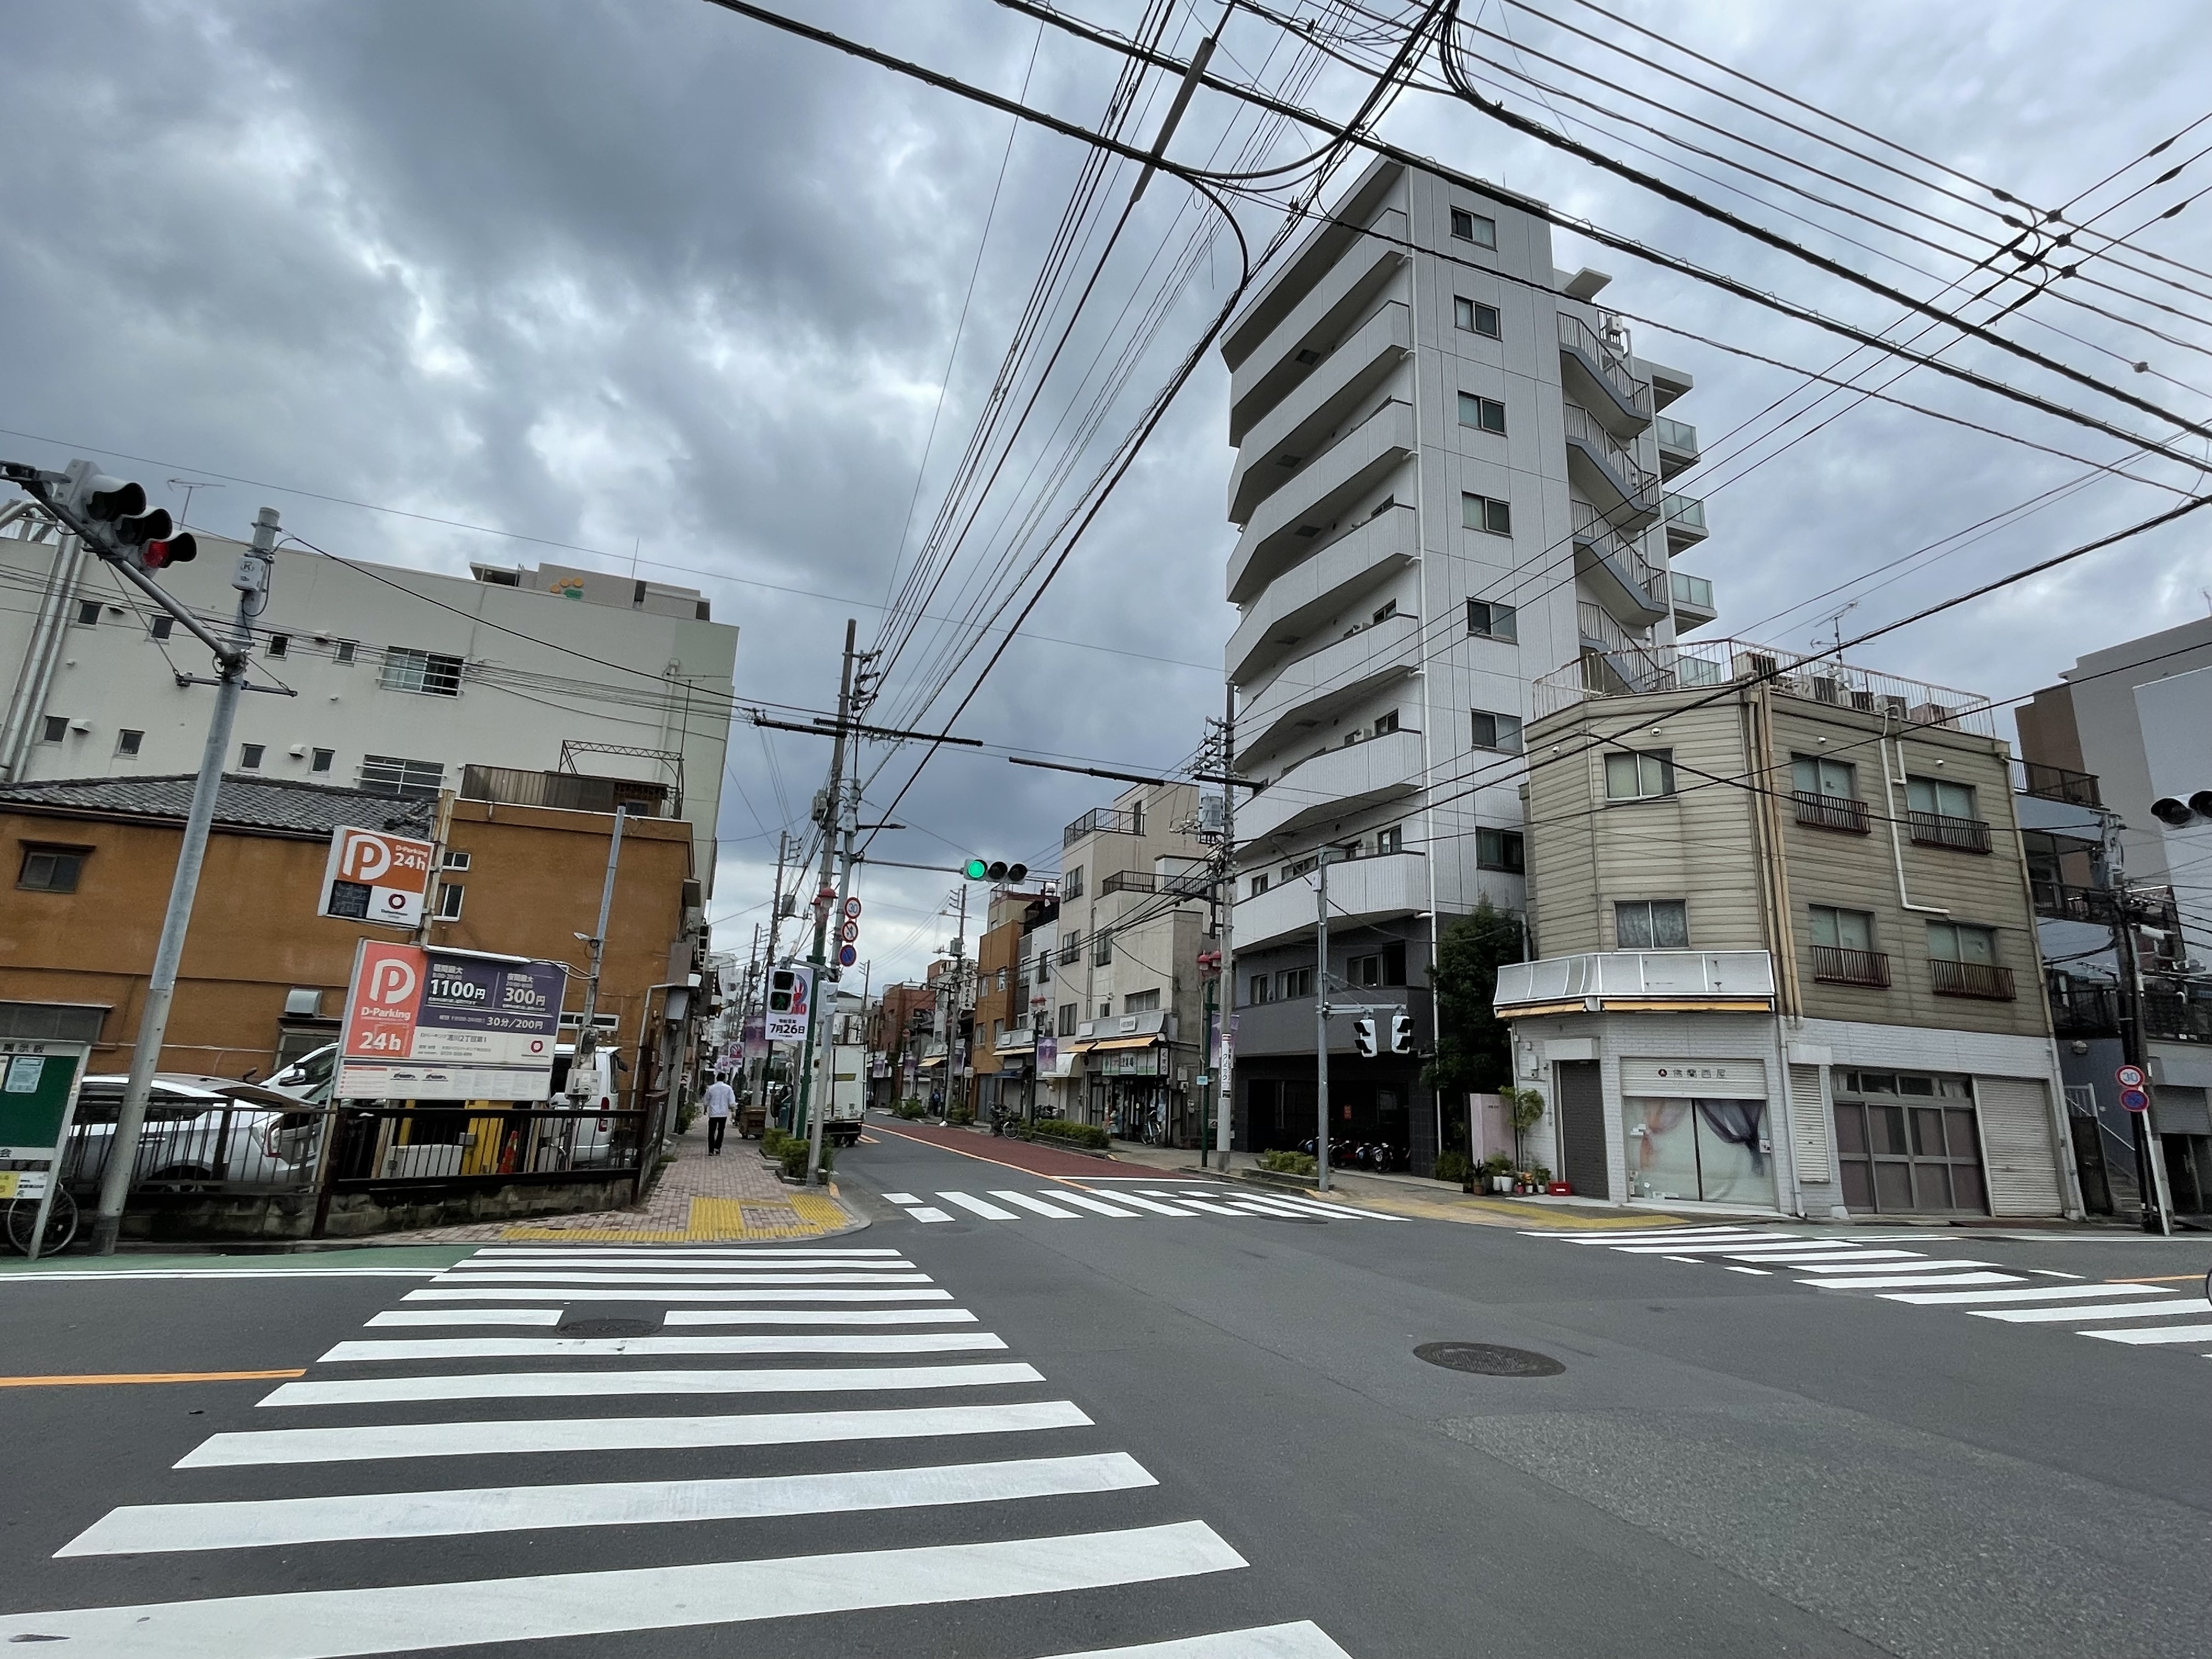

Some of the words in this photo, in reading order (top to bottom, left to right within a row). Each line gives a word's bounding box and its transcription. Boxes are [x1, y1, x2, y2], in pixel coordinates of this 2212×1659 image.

[393, 853, 426, 871] 24h
[848, 903, 857, 913] 30
[431, 979, 486, 1000] 1100円
[503, 987, 546, 1006] 300円
[360, 1007, 411, 1020] D-Parking
[486, 1016, 544, 1030] 30分/200円
[770, 1023, 805, 1034] 7月26日
[359, 1031, 401, 1051] 24h
[2122, 1072, 2139, 1082] 30
